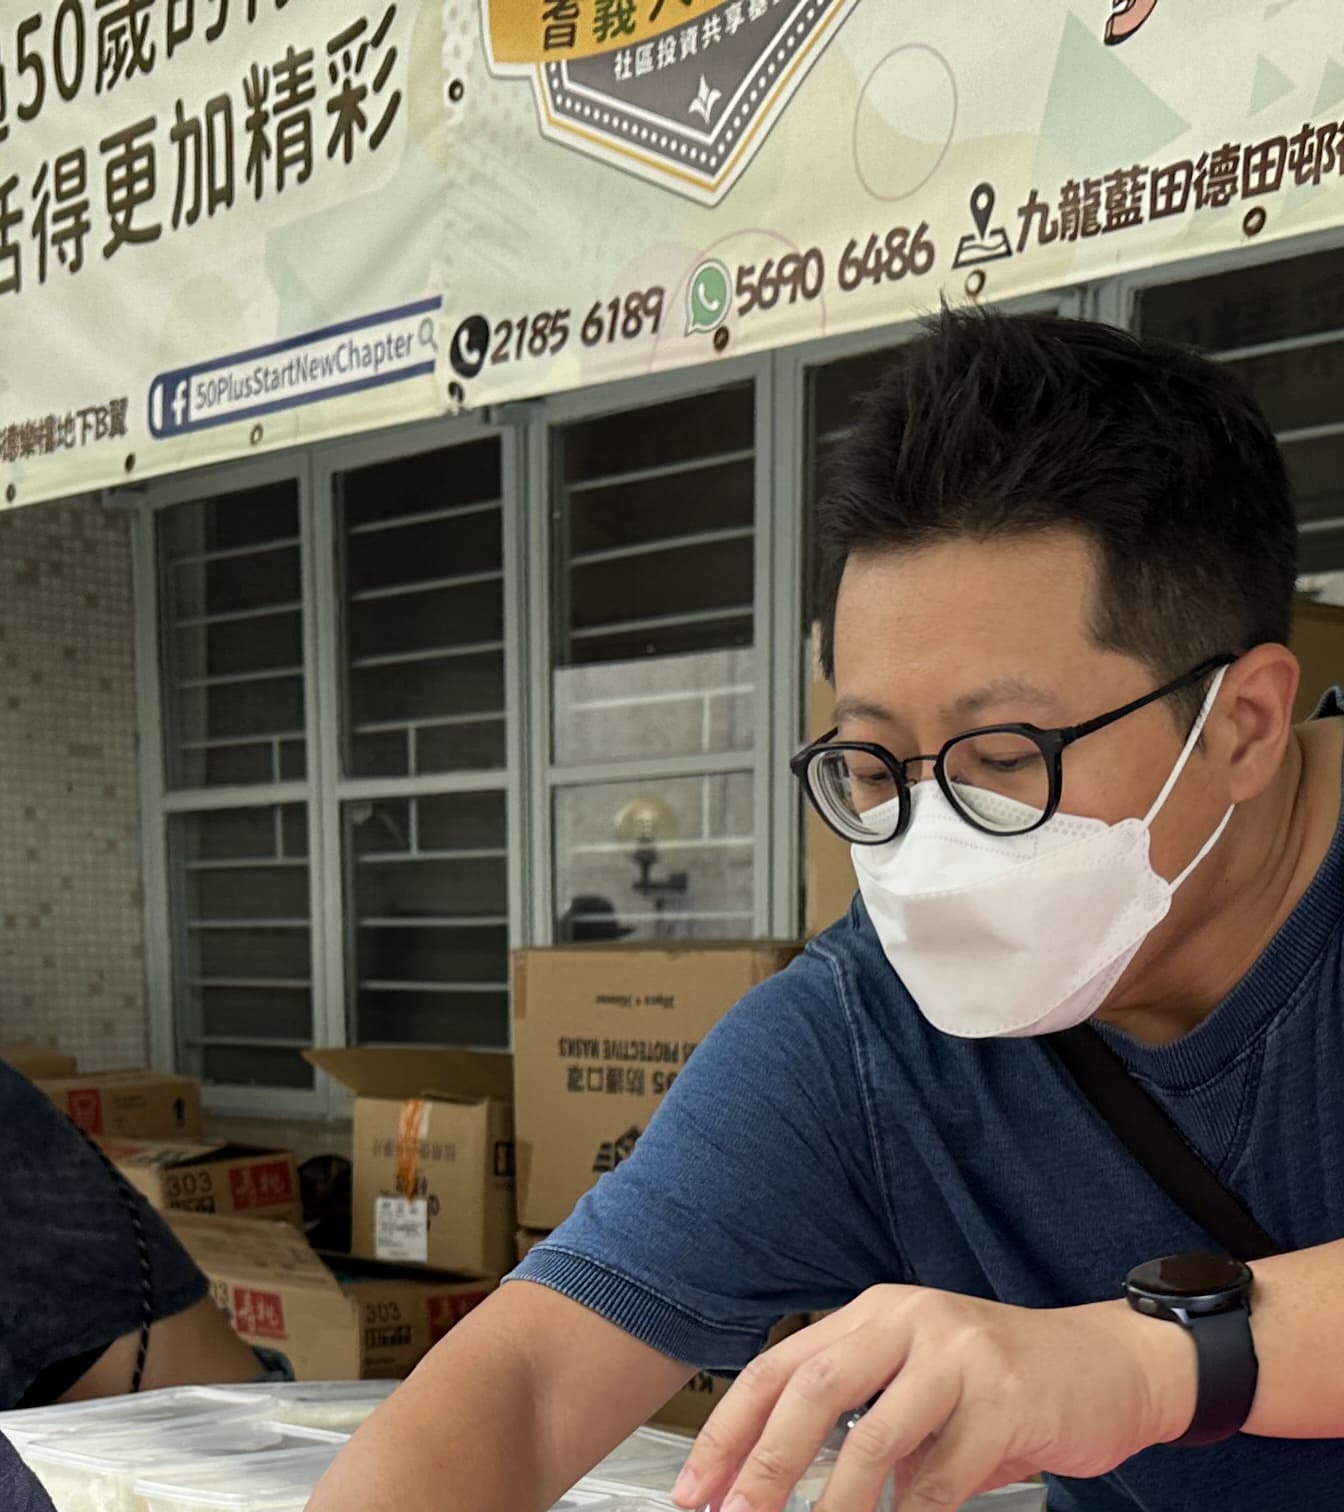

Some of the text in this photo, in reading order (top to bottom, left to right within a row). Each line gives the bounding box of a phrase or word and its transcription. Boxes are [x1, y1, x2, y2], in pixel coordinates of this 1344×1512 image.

[613, 0, 784, 82] 社區投資共享基
[735, 222, 935, 317] 5690 6486
[490, 285, 665, 366] 2185 6189
[194, 331, 414, 411] 50PlusStartNewChapter
[559, 1037, 600, 1060] MASKS
[602, 1040, 679, 1064] PROTECTIVE
[167, 1171, 213, 1197] 303
